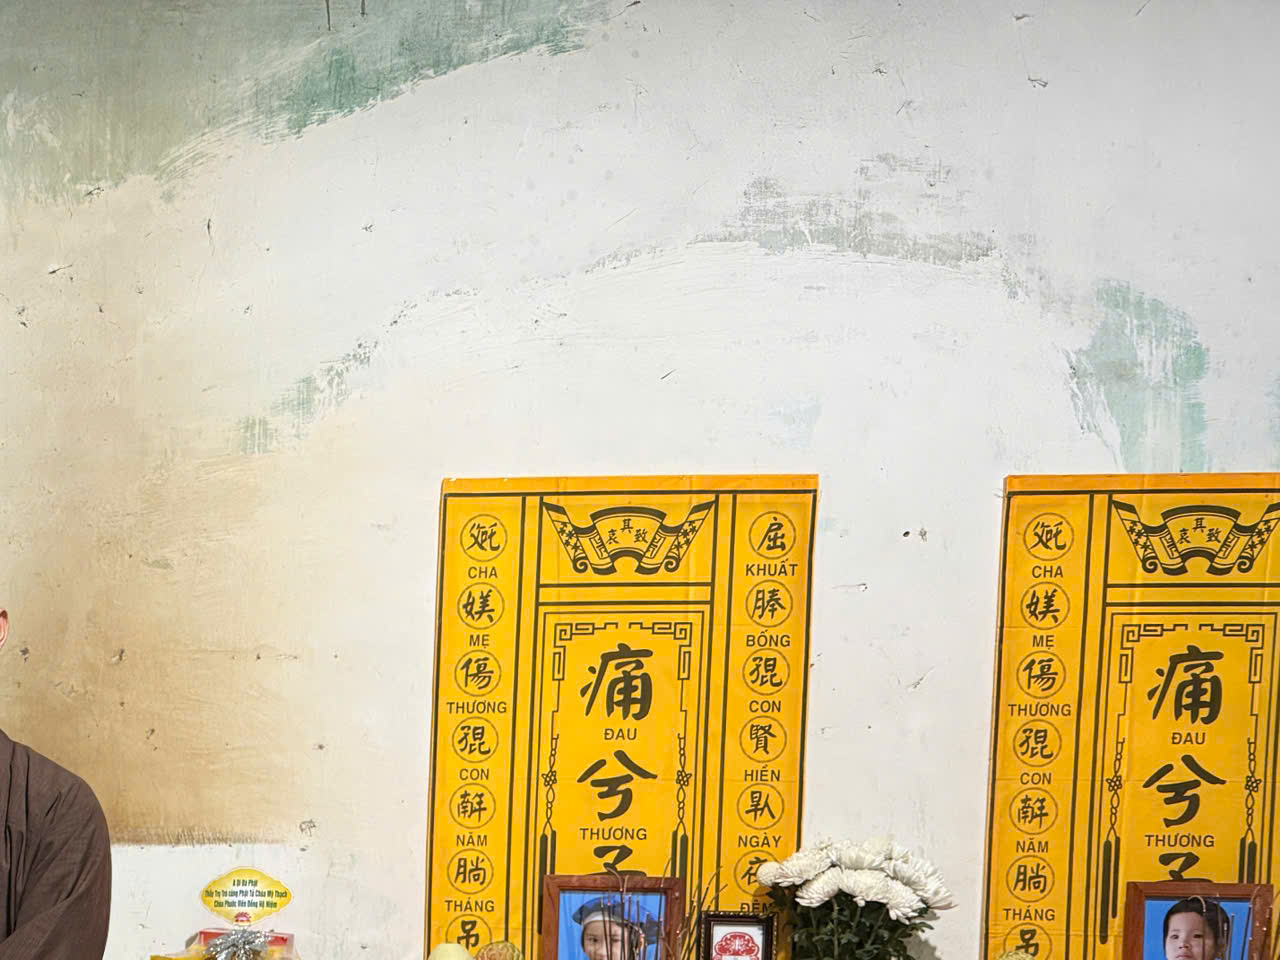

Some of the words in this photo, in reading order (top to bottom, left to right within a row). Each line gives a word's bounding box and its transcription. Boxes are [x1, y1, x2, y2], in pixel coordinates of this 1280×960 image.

[759, 517, 787, 553] 屈
[468, 567, 497, 579] CHA
[745, 557, 799, 577] KHUẤT
[1032, 566, 1063, 579] CHA
[470, 634, 489, 649] MẸ
[746, 629, 791, 647] BỐNG
[1033, 635, 1054, 649] MẸ
[580, 643, 653, 721] 痛
[1148, 644, 1225, 725] 痛
[447, 699, 507, 715] THƯƠNG
[750, 700, 781, 713] CON
[1008, 701, 1072, 717] THƯƠNG
[603, 727, 637, 741] ĐAU
[748, 723, 778, 756] 賢
[1171, 732, 1206, 745] ĐAU
[460, 769, 490, 781] CON
[744, 764, 781, 782] HIỀN
[1020, 773, 1051, 785] CON
[577, 750, 657, 821] 兮
[1143, 755, 1227, 828] 兮
[457, 831, 487, 847] NĂM
[579, 826, 647, 841] THƯƠNG
[738, 830, 782, 848] NGÀY
[1145, 832, 1215, 848] THƯƠNG
[1016, 838, 1048, 854] NĂM
[445, 896, 495, 912] THÁNG
[1003, 904, 1055, 921] THÁNG
